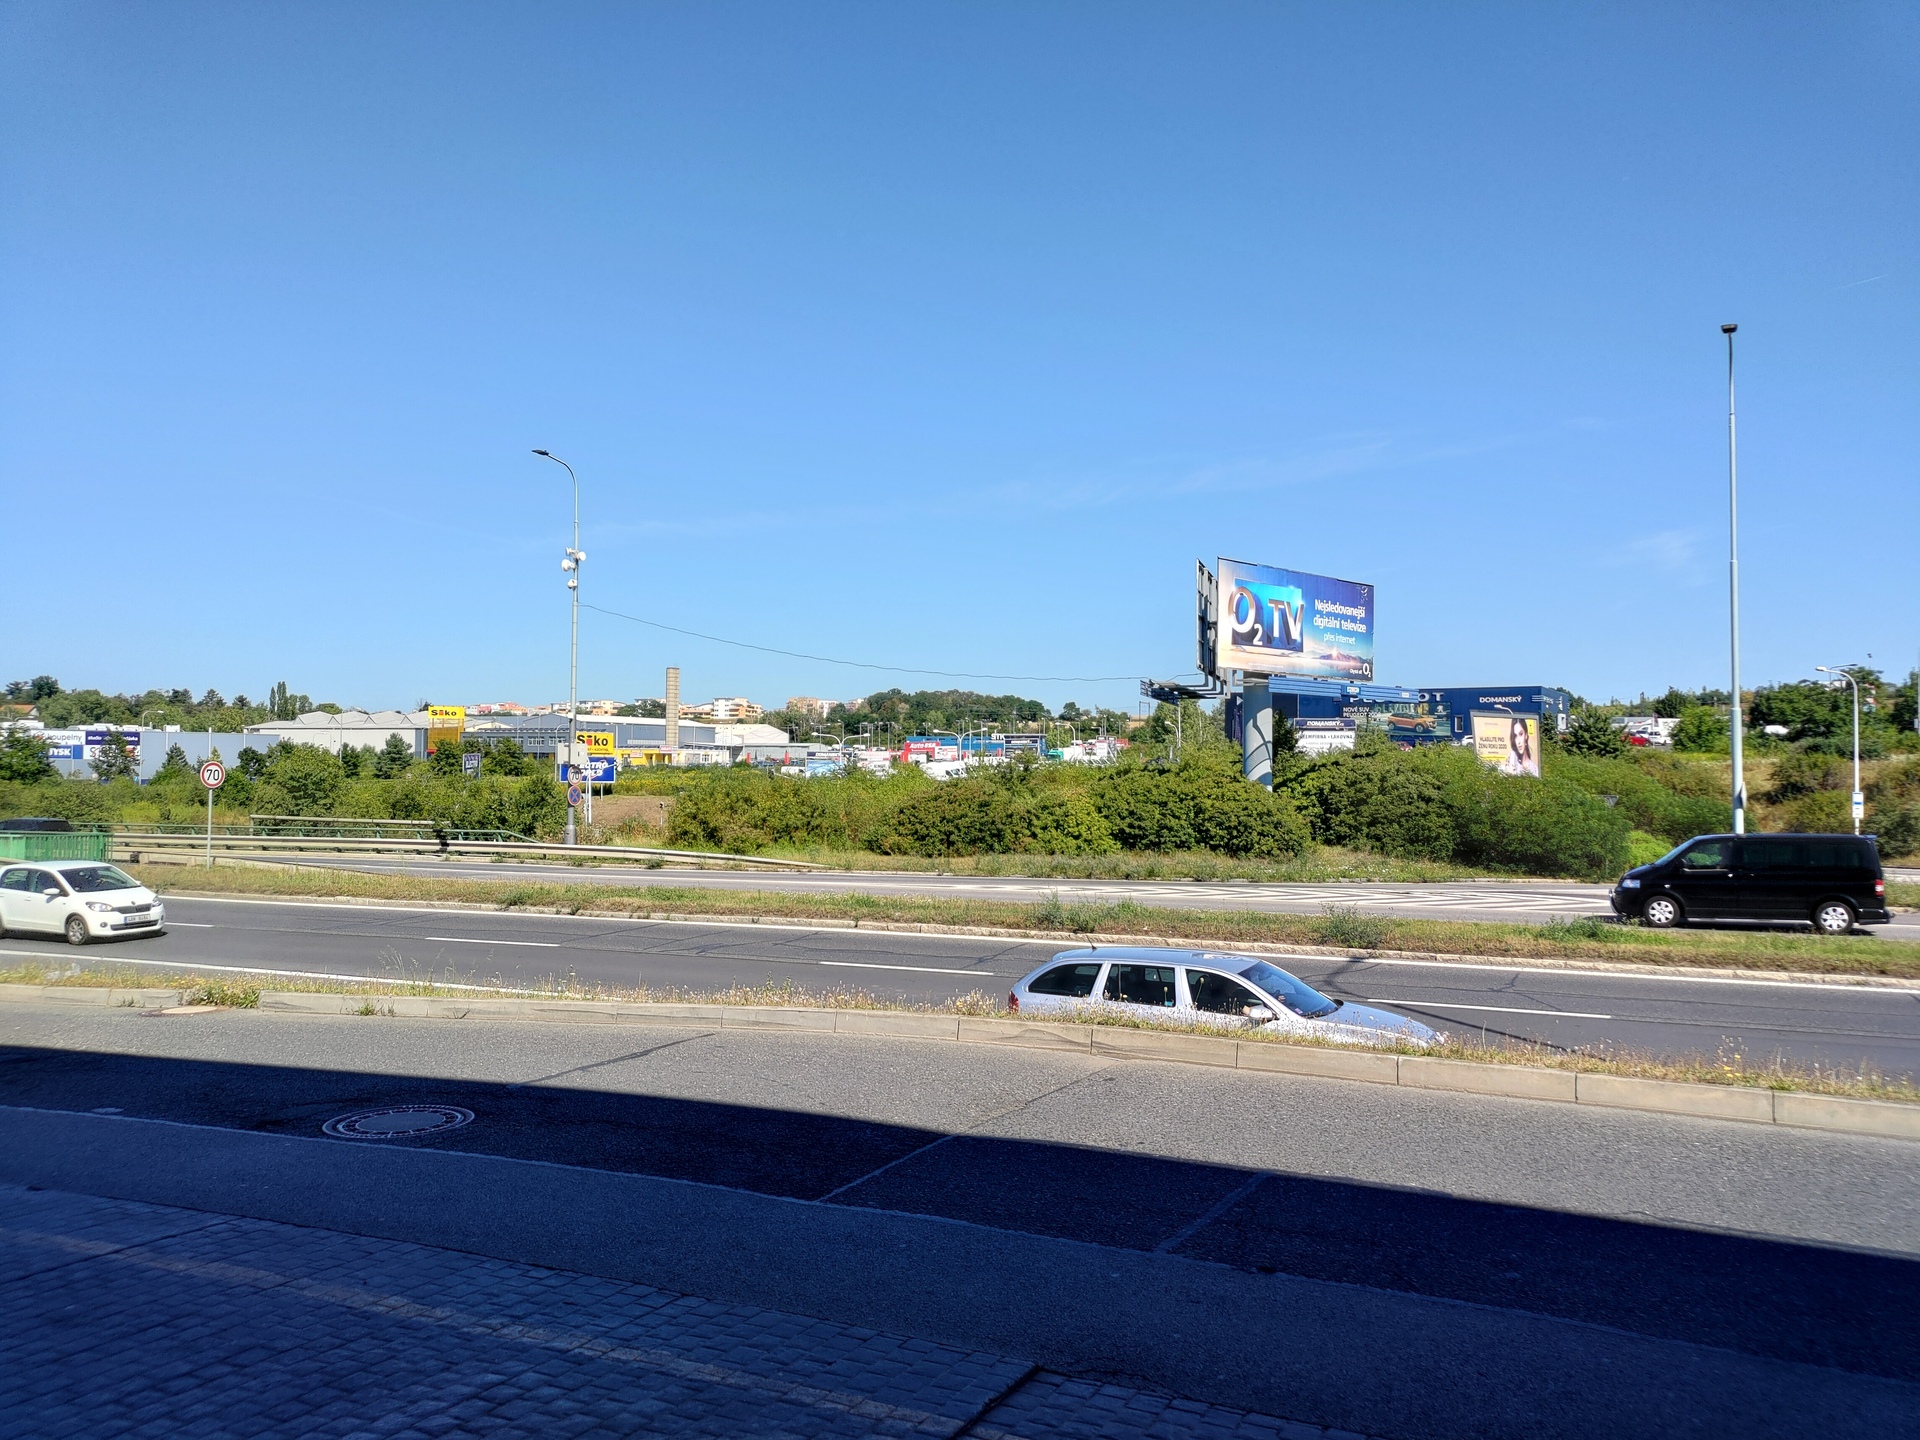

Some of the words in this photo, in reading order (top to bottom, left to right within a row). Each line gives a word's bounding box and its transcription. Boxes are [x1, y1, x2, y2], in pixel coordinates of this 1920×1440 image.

[1268, 598, 1304, 640] TV
[1341, 618, 1366, 633] televize
[1335, 632, 1355, 645] internet
[49, 748, 72, 756] JYSK
[207, 769, 219, 781] 70
[571, 770, 579, 780] 70
